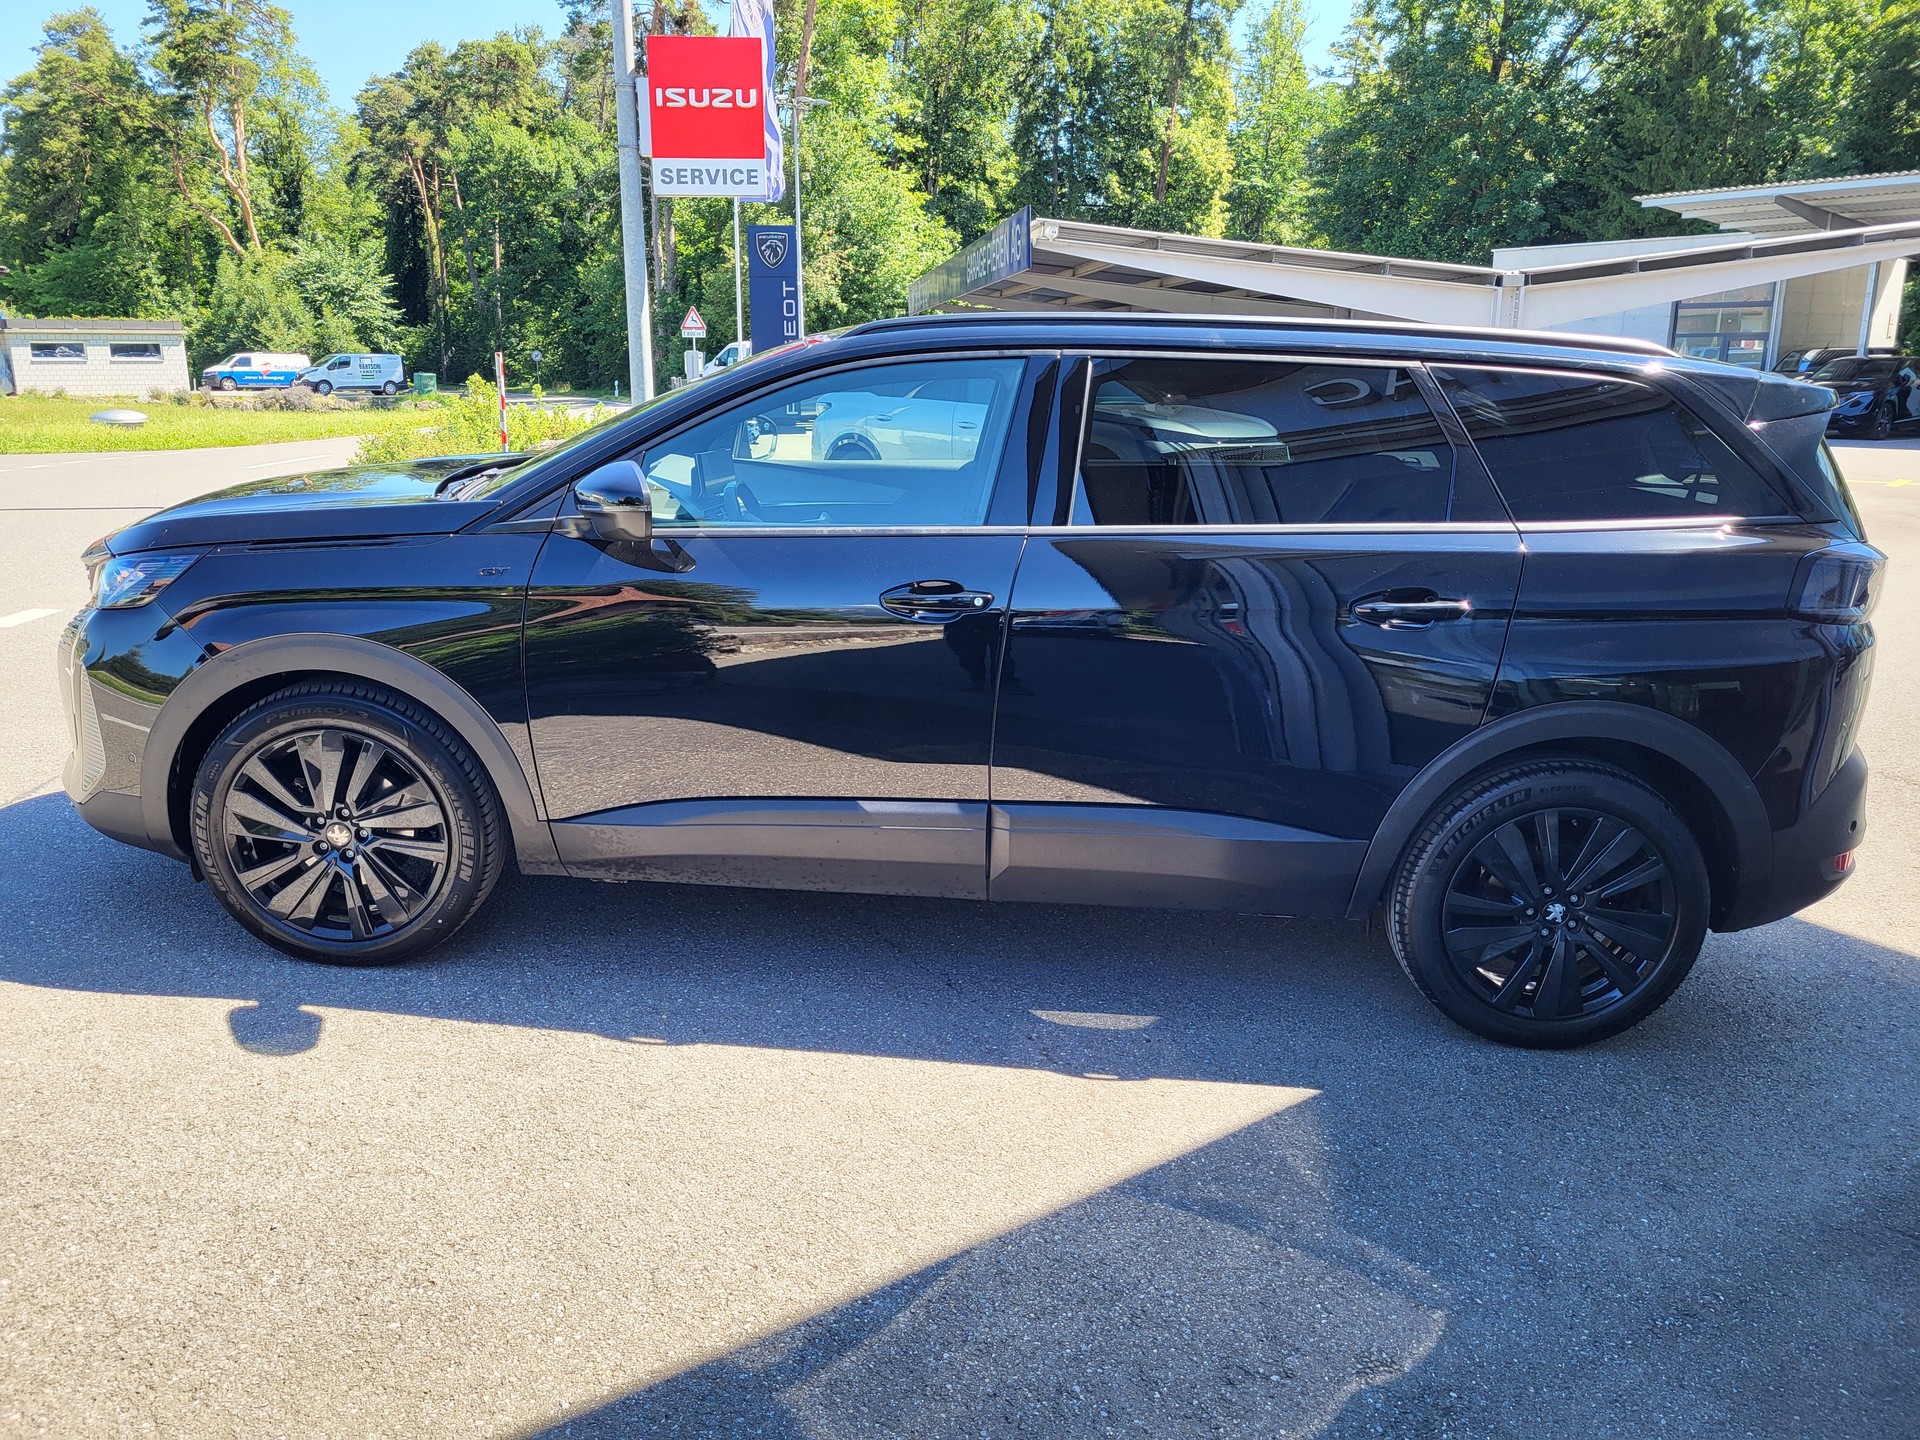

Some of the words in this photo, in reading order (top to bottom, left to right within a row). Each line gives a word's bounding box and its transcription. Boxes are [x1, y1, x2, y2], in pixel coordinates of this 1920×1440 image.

[655, 87, 758, 109] ISUZU
[660, 167, 760, 186] SERVICE
[1010, 223, 1022, 264] AG
[478, 566, 511, 577] GT
[265, 705, 349, 725] PRIMACY
[445, 783, 476, 884] MICHELIN
[1443, 790, 1530, 855] MICHELIN
[195, 790, 227, 892] MICHELIN
